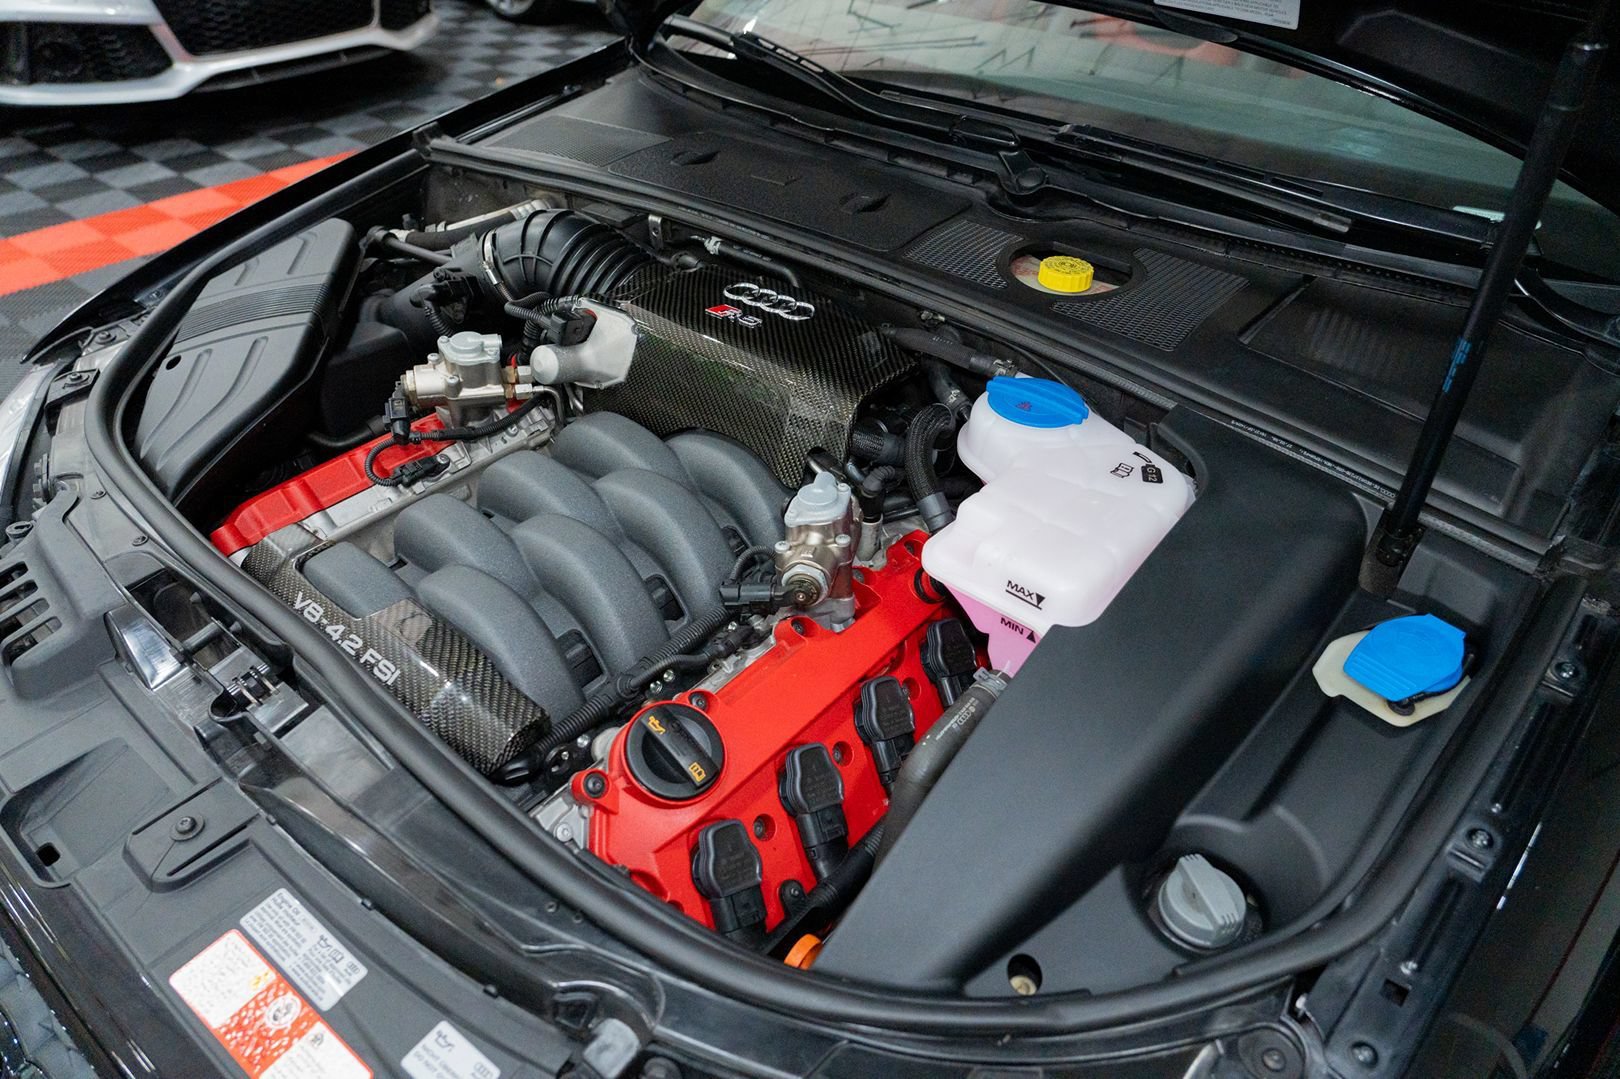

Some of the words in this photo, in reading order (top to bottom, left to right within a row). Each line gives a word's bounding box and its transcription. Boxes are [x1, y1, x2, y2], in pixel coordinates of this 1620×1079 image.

[1148, 474, 1158, 482] 12
[1006, 579, 1035, 601] MAX
[1000, 616, 1024, 635] MIN
[293, 591, 363, 656] V8-4.2
[360, 647, 401, 686] FSI
